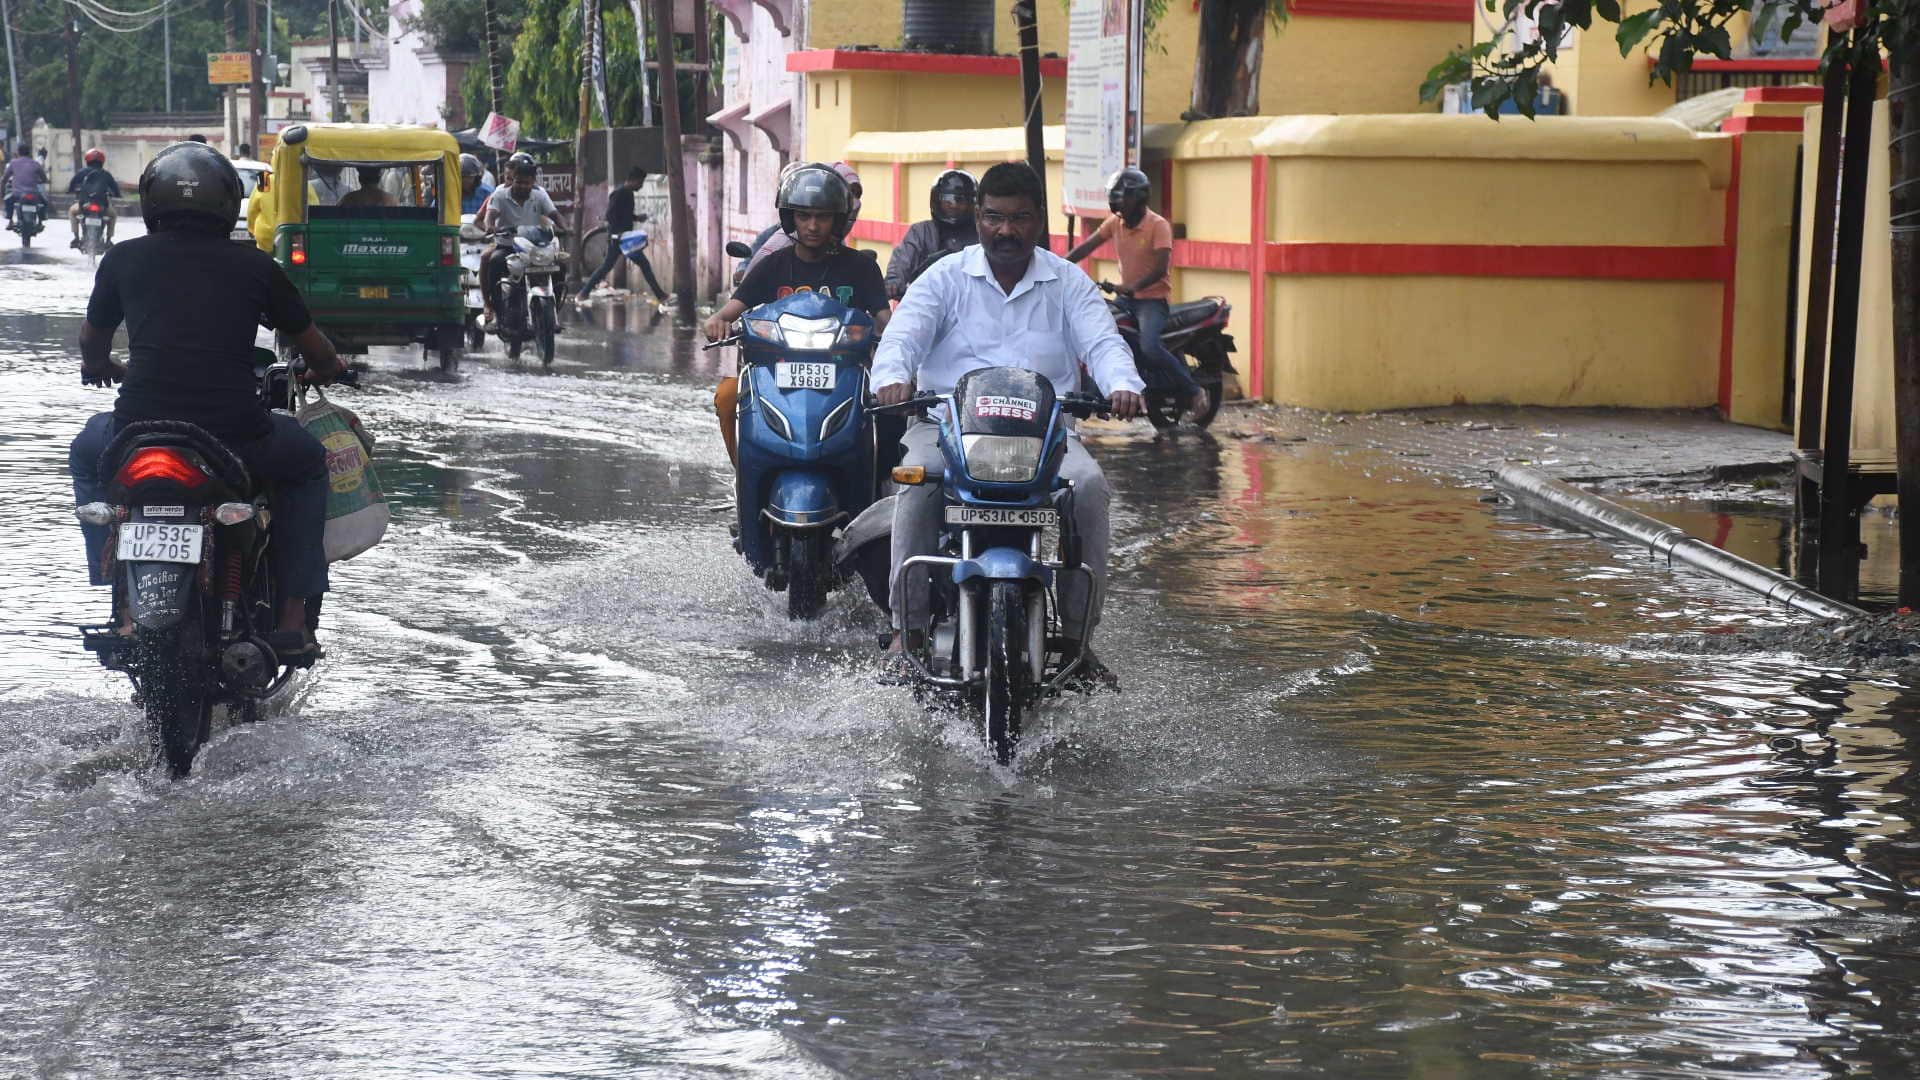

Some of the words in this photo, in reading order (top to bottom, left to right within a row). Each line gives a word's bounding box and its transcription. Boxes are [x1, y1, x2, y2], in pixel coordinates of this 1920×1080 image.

[790, 364, 830, 376] UP53C
[790, 375, 829, 388] X9687
[992, 398, 1034, 409] CHANNEL
[978, 407, 1033, 420] PRESS
[961, 510, 977, 521] UP
[134, 525, 192, 543] UP53C
[133, 543, 191, 560] U4705
